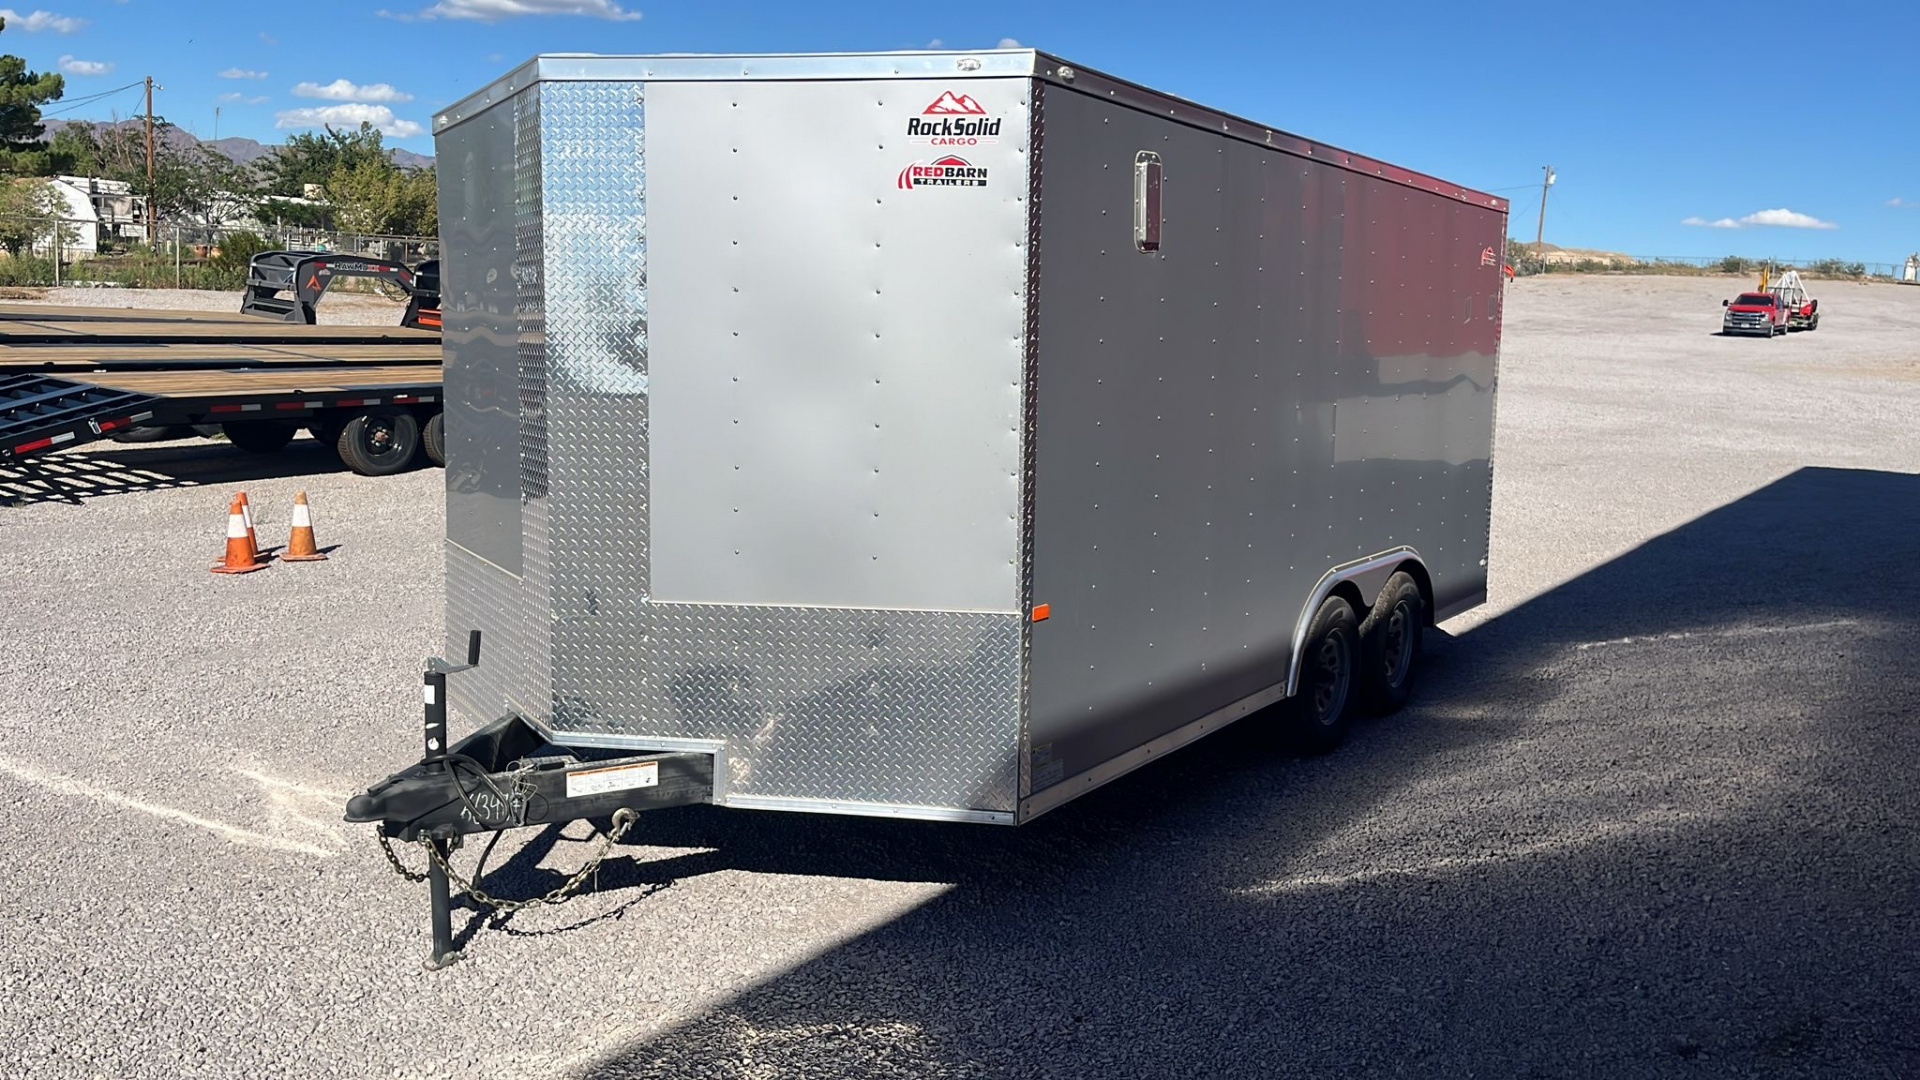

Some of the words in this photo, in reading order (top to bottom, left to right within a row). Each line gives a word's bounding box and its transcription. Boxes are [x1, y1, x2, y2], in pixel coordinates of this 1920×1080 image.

[908, 117, 1001, 136] RockSolid
[931, 137, 978, 146] CARGO
[920, 179, 978, 187] TRAILERS
